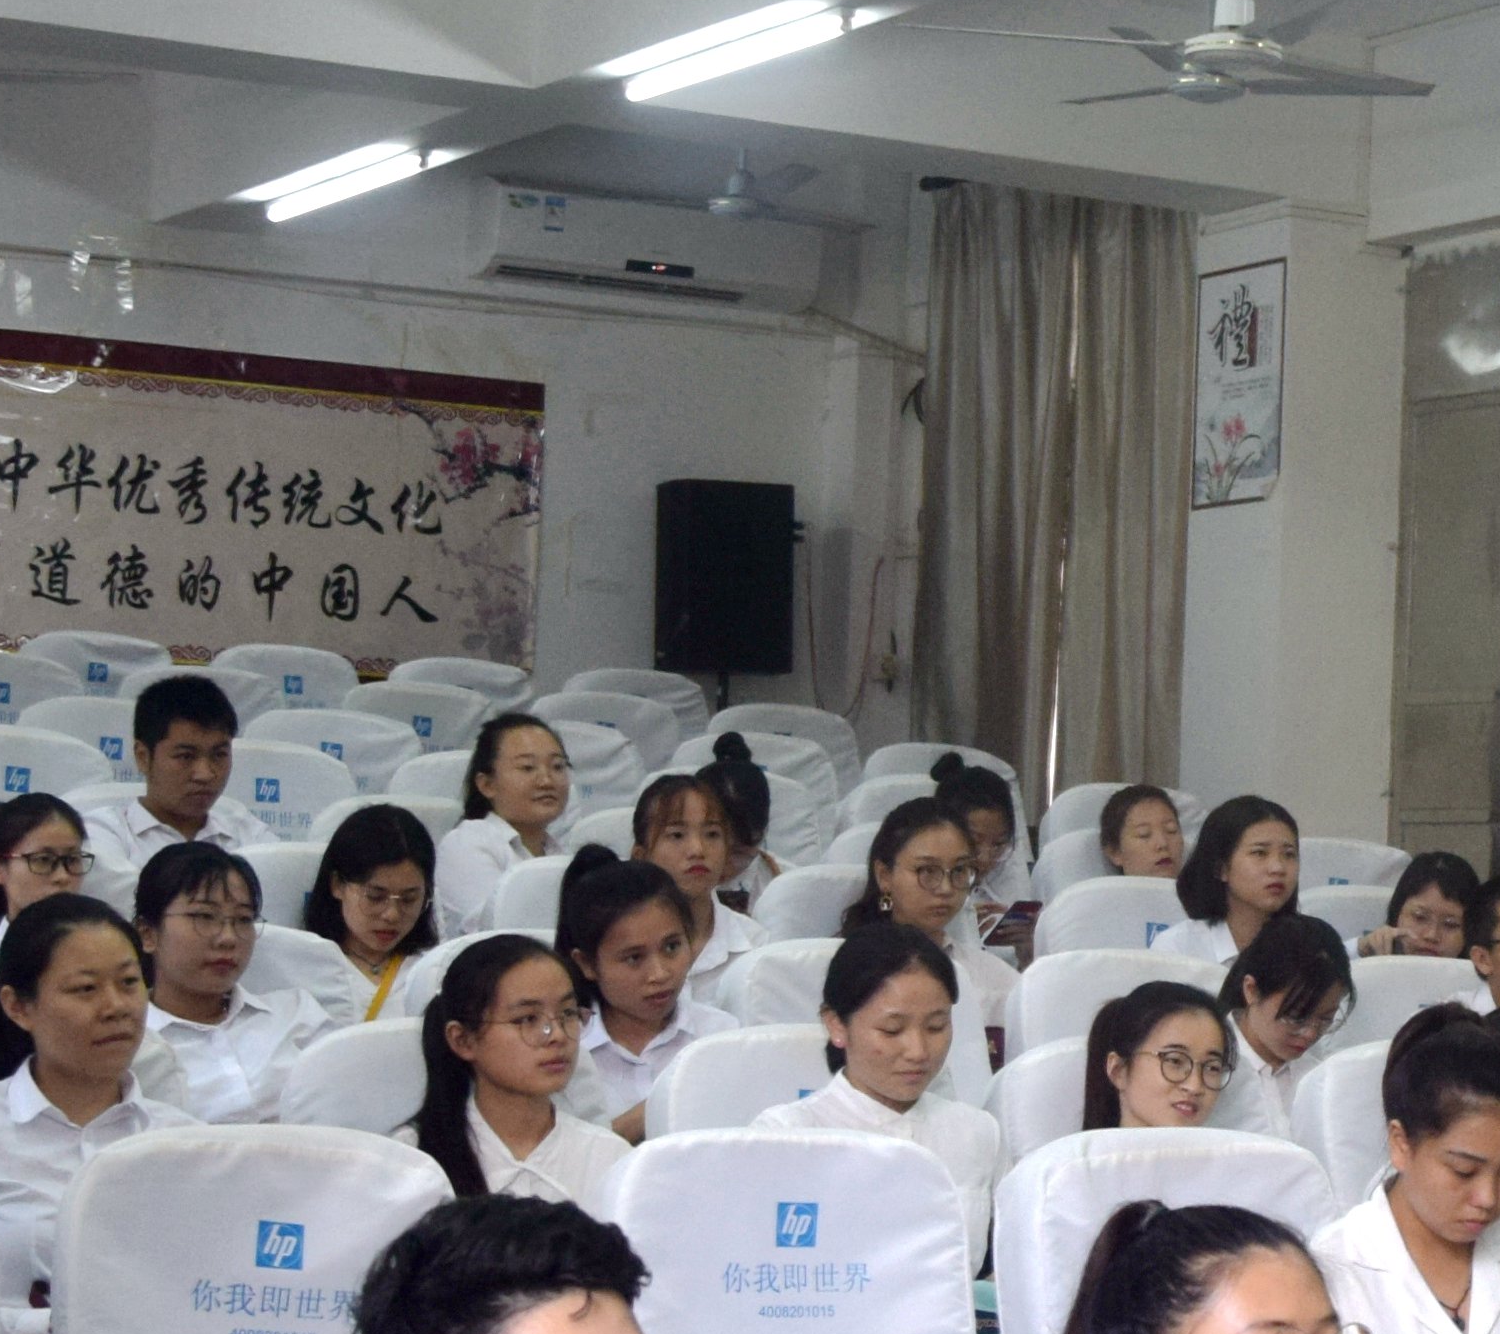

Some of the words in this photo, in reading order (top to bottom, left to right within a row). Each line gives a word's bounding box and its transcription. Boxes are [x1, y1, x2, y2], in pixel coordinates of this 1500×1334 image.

[8, 767, 28, 792] hp
[258, 779, 278, 801] hp
[783, 1203, 815, 1247] hp
[261, 1222, 301, 1268] hp
[722, 1261, 872, 1296] 你我即世界
[191, 1278, 361, 1323] 你我即世界
[758, 1305, 836, 1320] 4008201015
